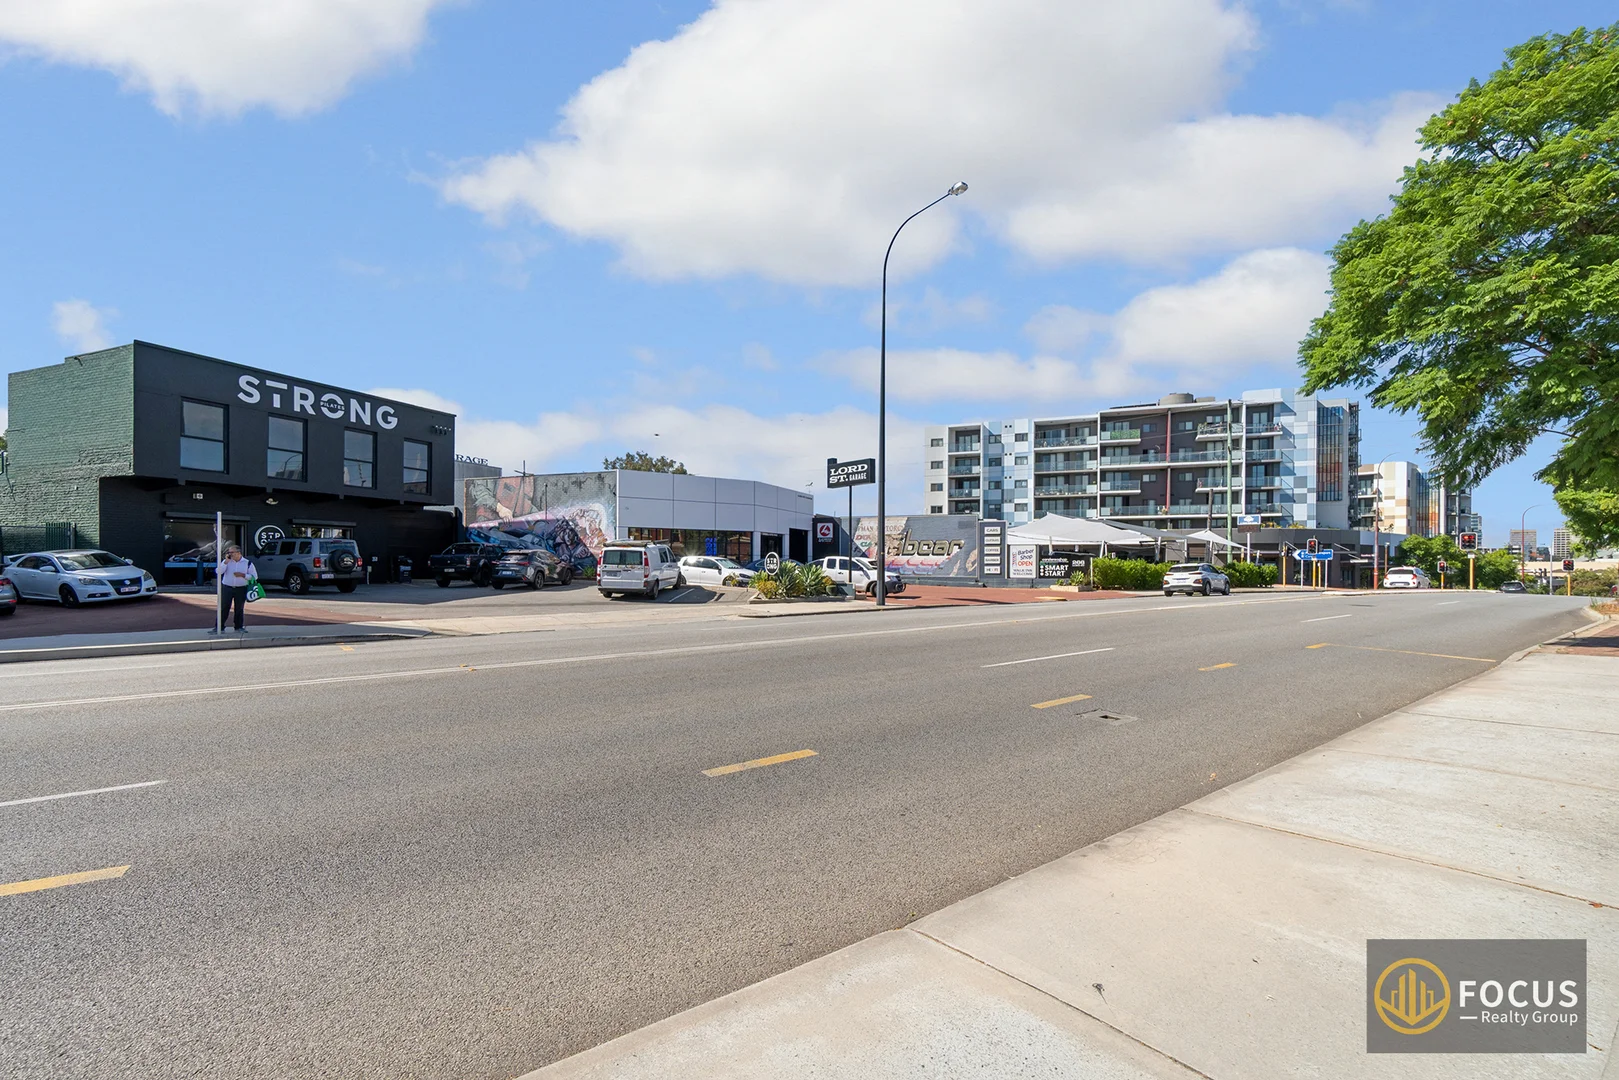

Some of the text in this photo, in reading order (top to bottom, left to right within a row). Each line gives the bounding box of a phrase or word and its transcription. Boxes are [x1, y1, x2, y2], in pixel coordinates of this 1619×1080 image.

[237, 374, 398, 430] STRONG
[320, 401, 345, 411] PILATES
[829, 463, 868, 476] LORD
[829, 472, 867, 484] ST. GARAGE
